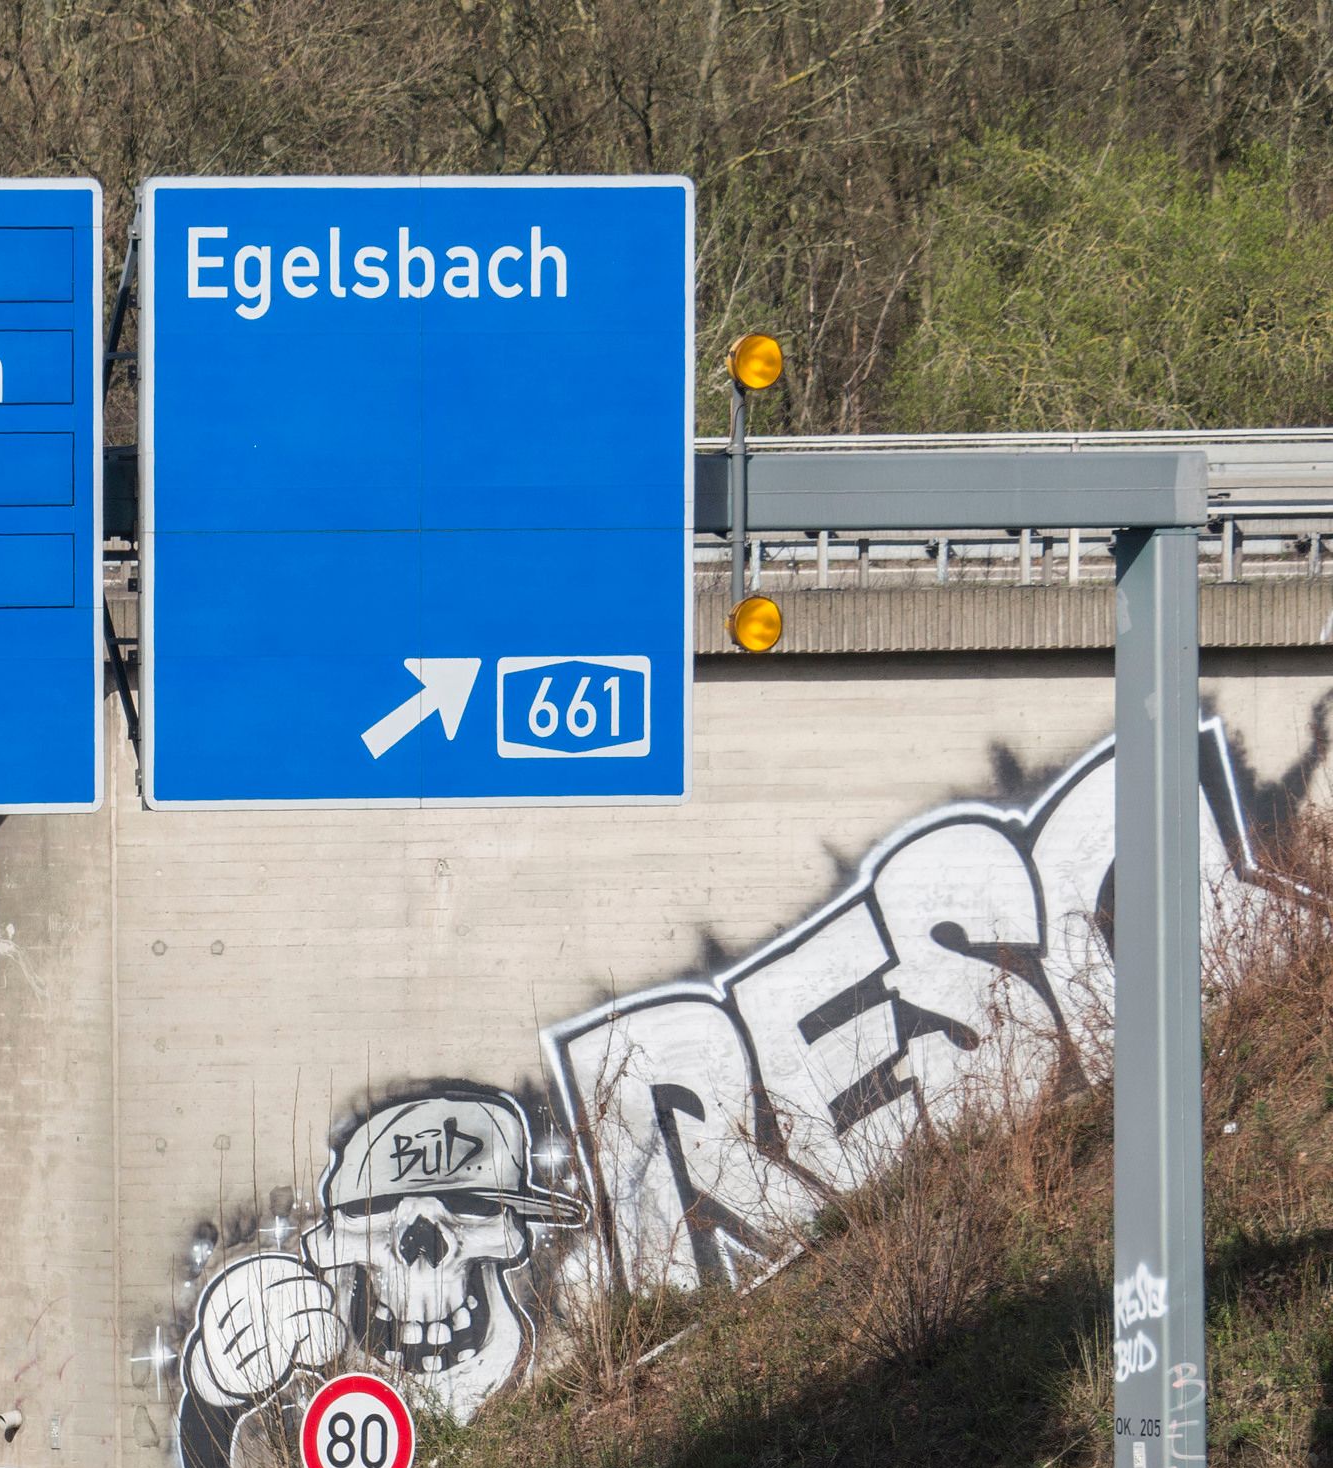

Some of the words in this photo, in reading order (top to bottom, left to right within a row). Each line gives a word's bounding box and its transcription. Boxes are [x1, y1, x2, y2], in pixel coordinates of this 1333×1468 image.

[186, 225, 569, 320] Egelsbach
[528, 675, 621, 738] 661
[1140, 1418, 1162, 1438] 205
